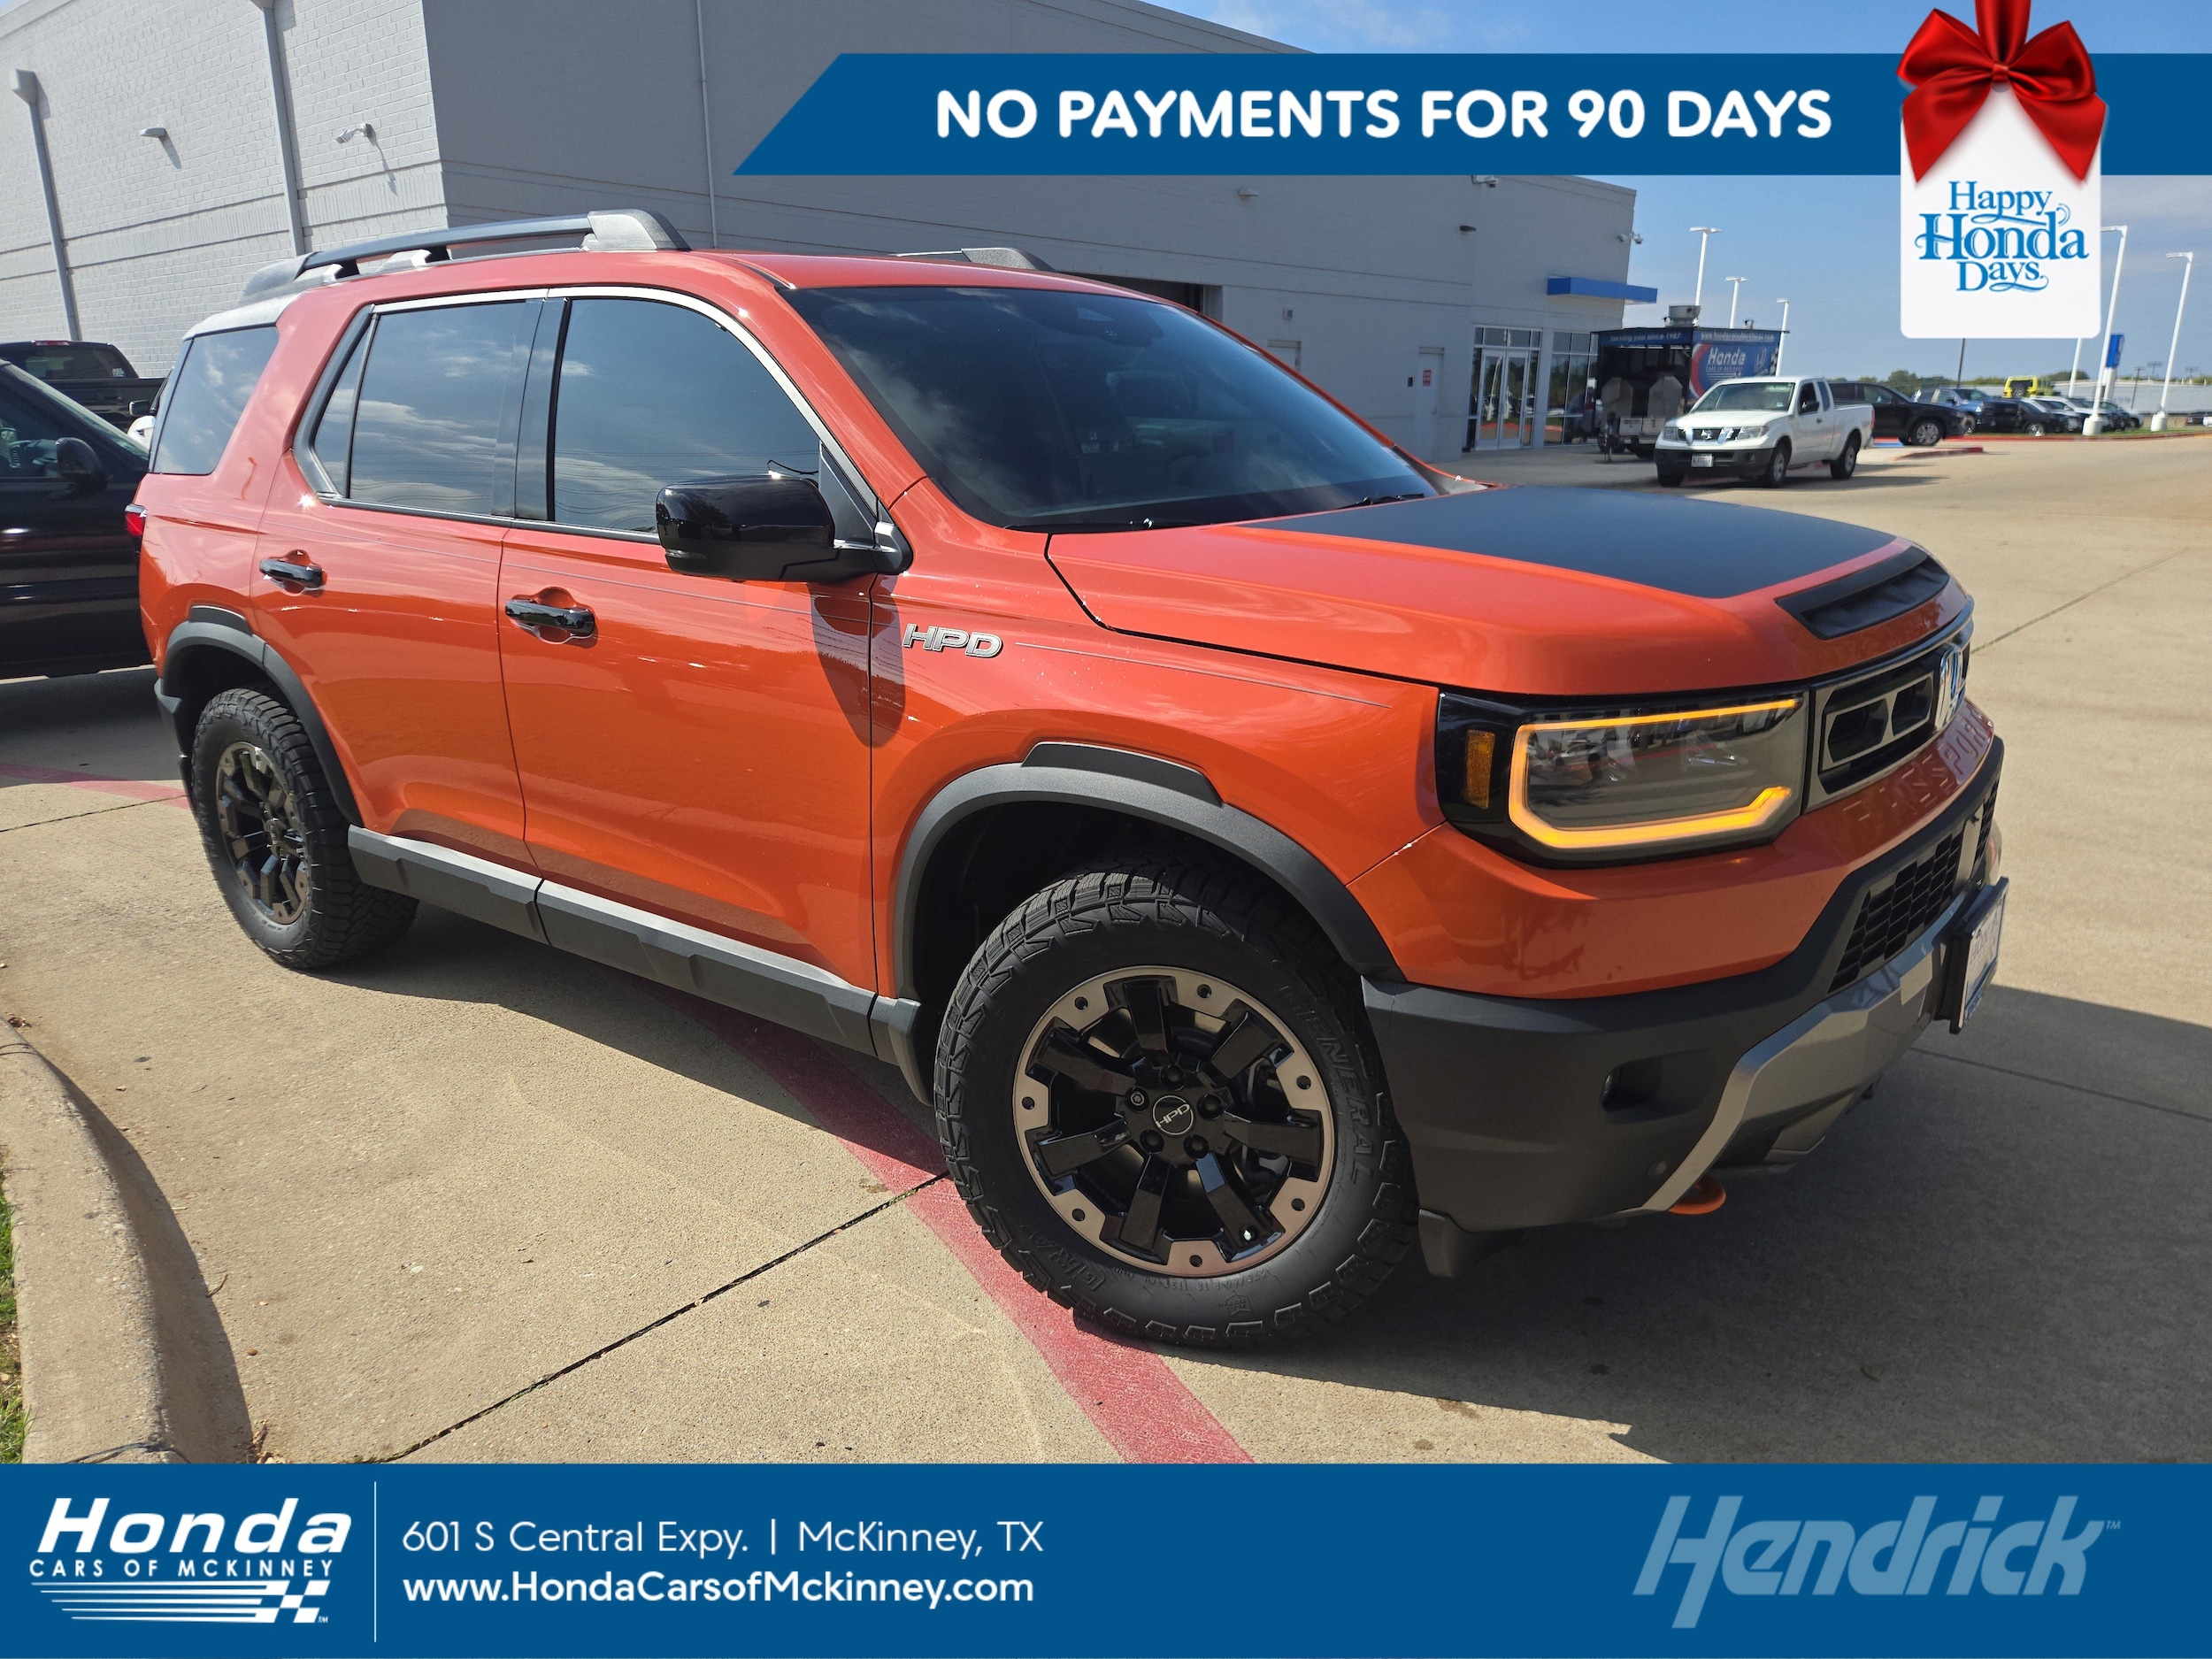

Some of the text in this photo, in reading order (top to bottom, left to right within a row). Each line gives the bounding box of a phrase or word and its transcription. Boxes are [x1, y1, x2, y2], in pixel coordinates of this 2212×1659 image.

[1707, 346, 1747, 365] Honda
[902, 623, 1003, 658] HPD
[1155, 1103, 1191, 1128] HPD
